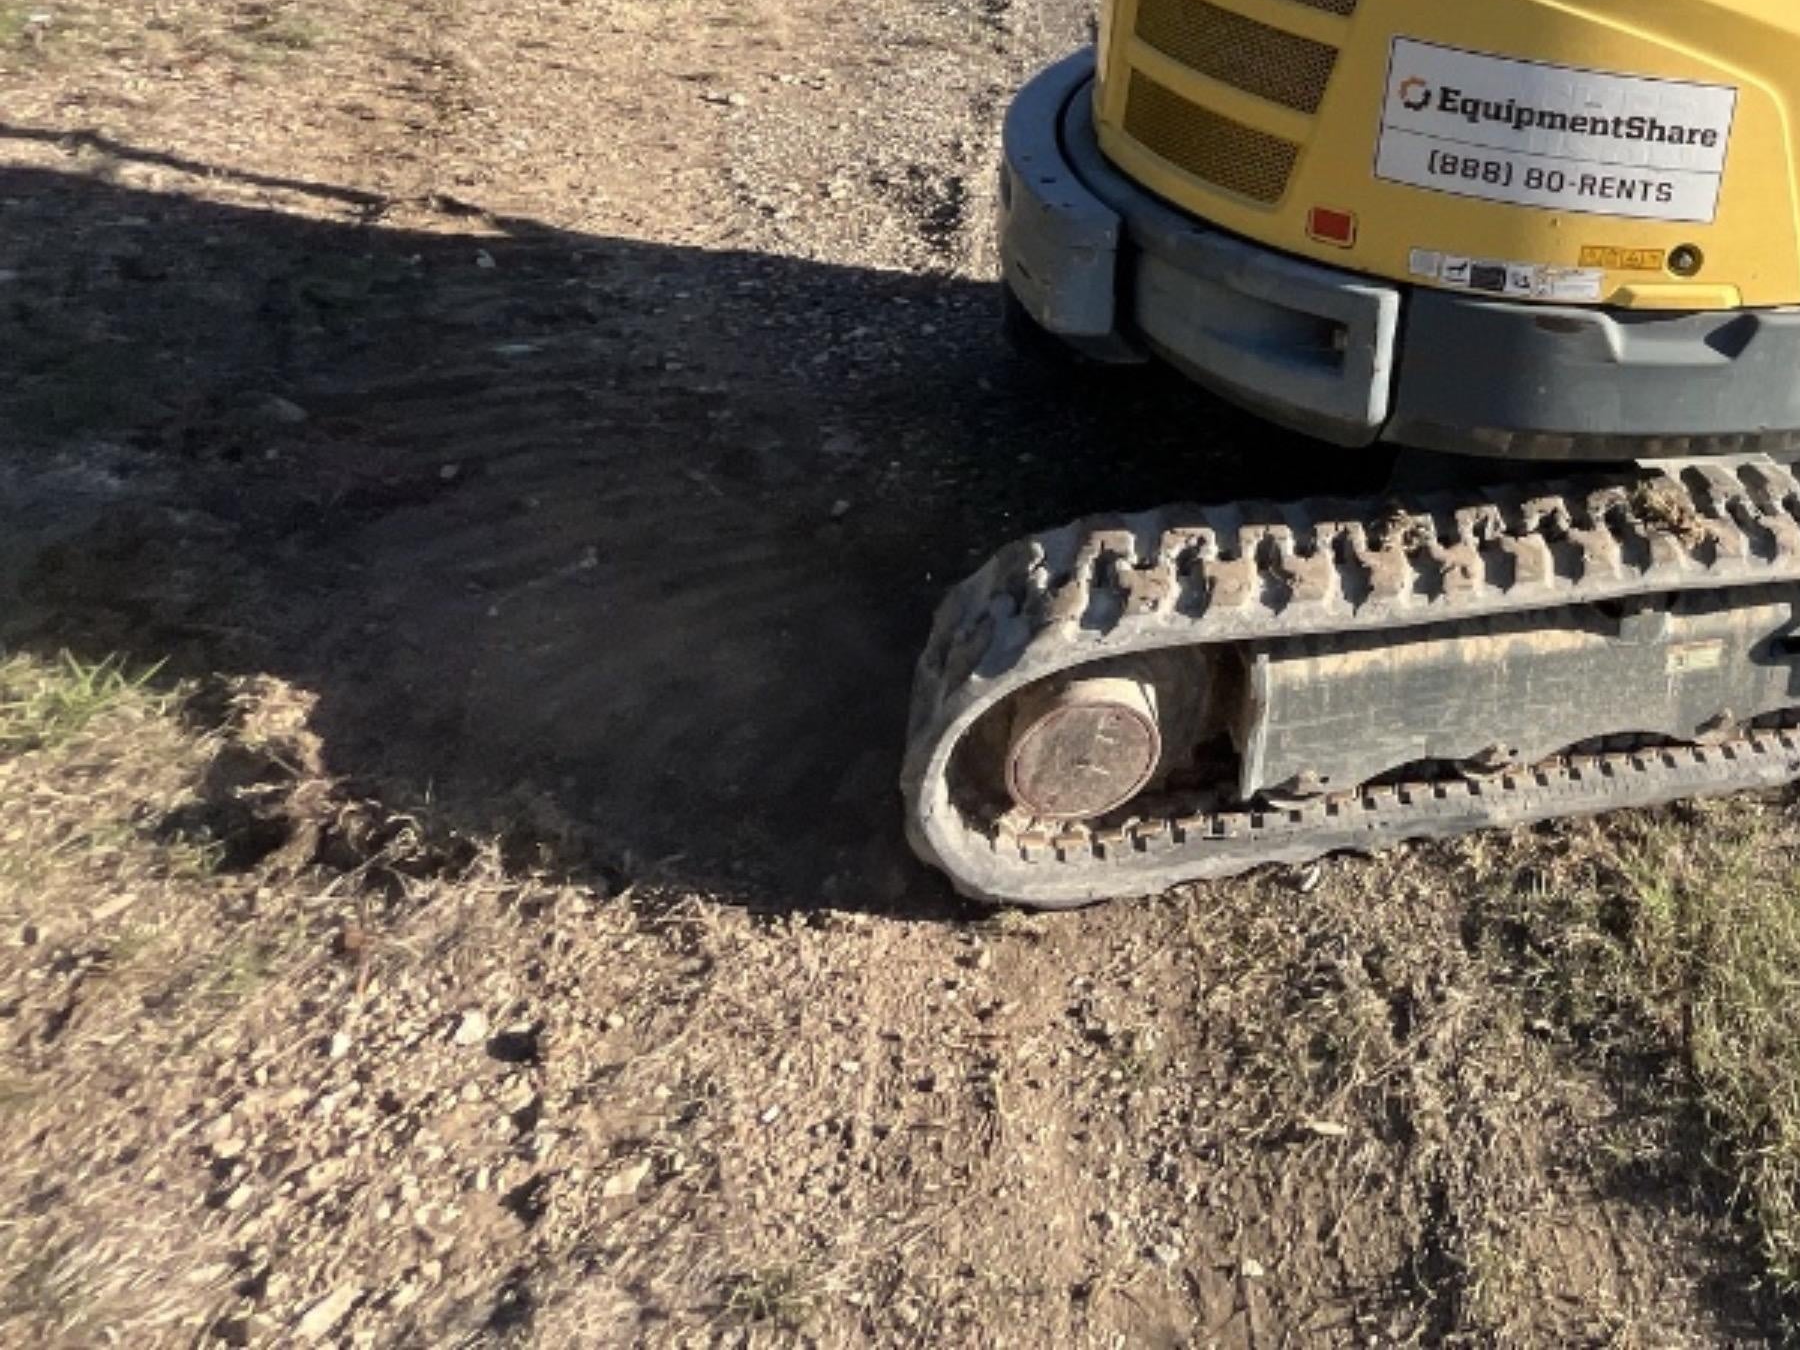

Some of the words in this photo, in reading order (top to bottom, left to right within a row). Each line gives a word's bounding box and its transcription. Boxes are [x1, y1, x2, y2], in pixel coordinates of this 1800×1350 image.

[1438, 86, 1718, 147] EquipmentShare
[1427, 149, 1513, 187] (888)
[1524, 169, 1674, 203] 80-RENTS
